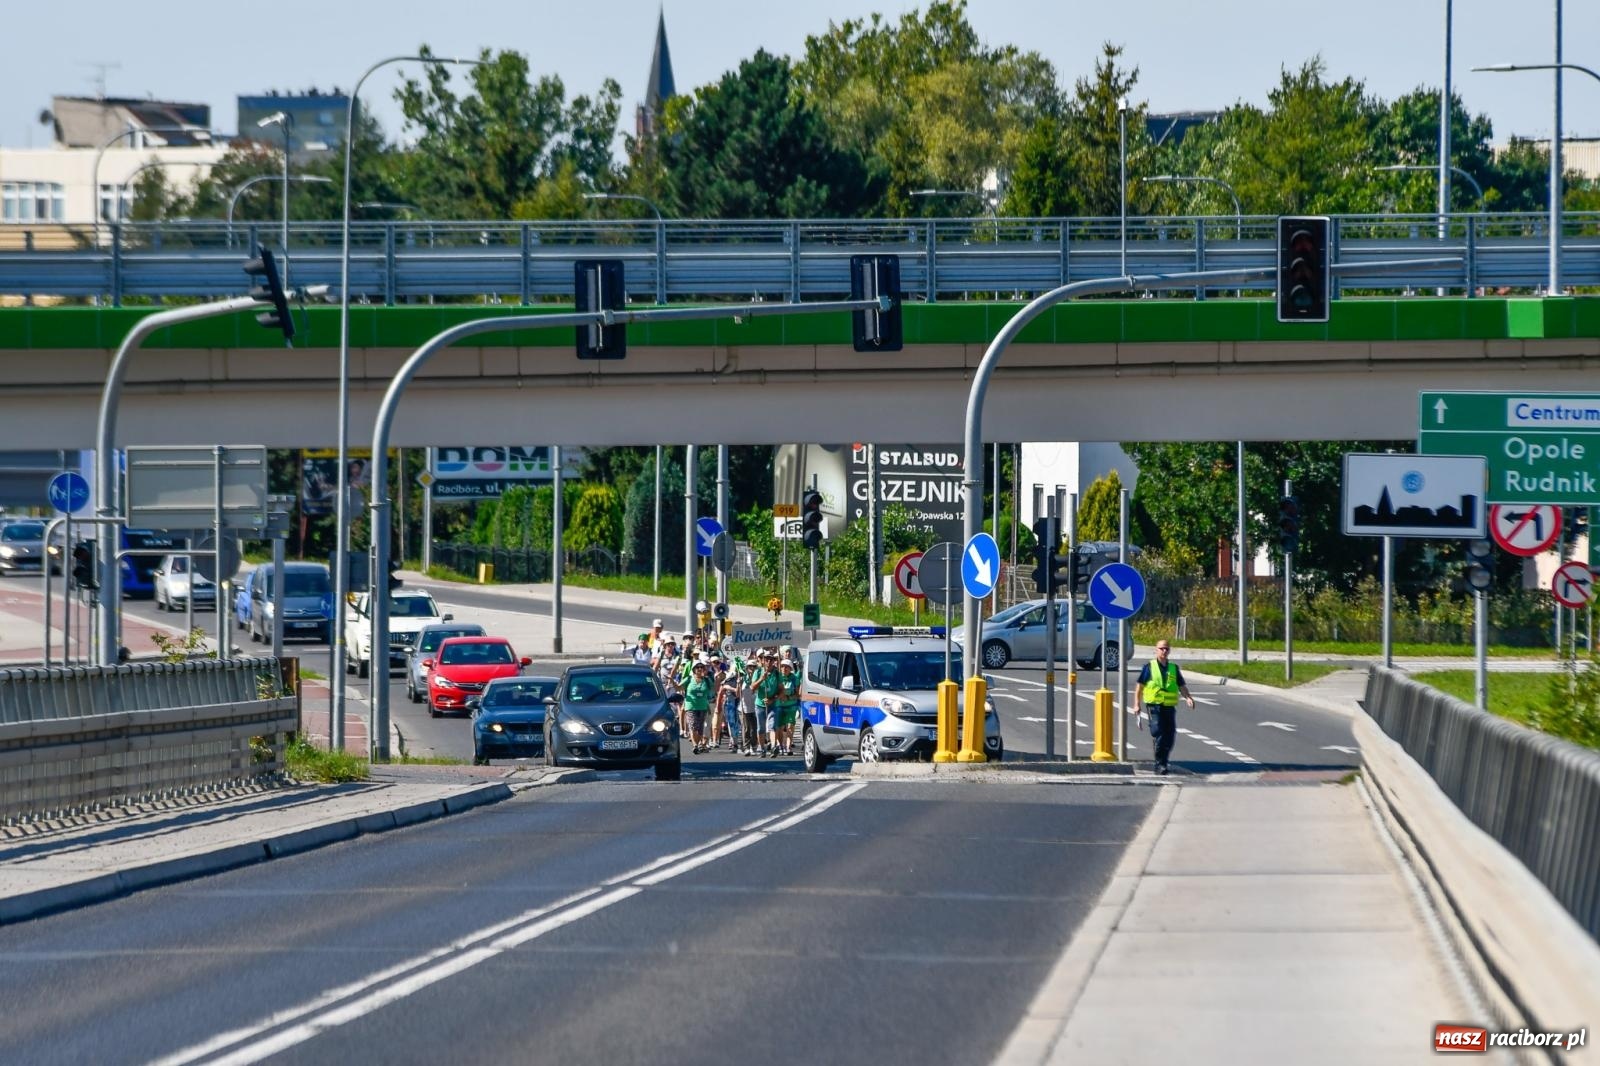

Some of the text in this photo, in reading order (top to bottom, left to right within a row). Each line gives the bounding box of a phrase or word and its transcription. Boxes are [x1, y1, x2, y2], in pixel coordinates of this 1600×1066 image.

[1515, 403, 1600, 420] Centrum
[437, 446, 549, 472] DOM
[1504, 437, 1585, 465] Opole
[880, 451, 966, 470] STALBUD.
[1506, 471, 1596, 493] Rudnik
[778, 506, 794, 515] 919
[806, 606, 817, 623] 5
[734, 627, 792, 644] Racibórz
